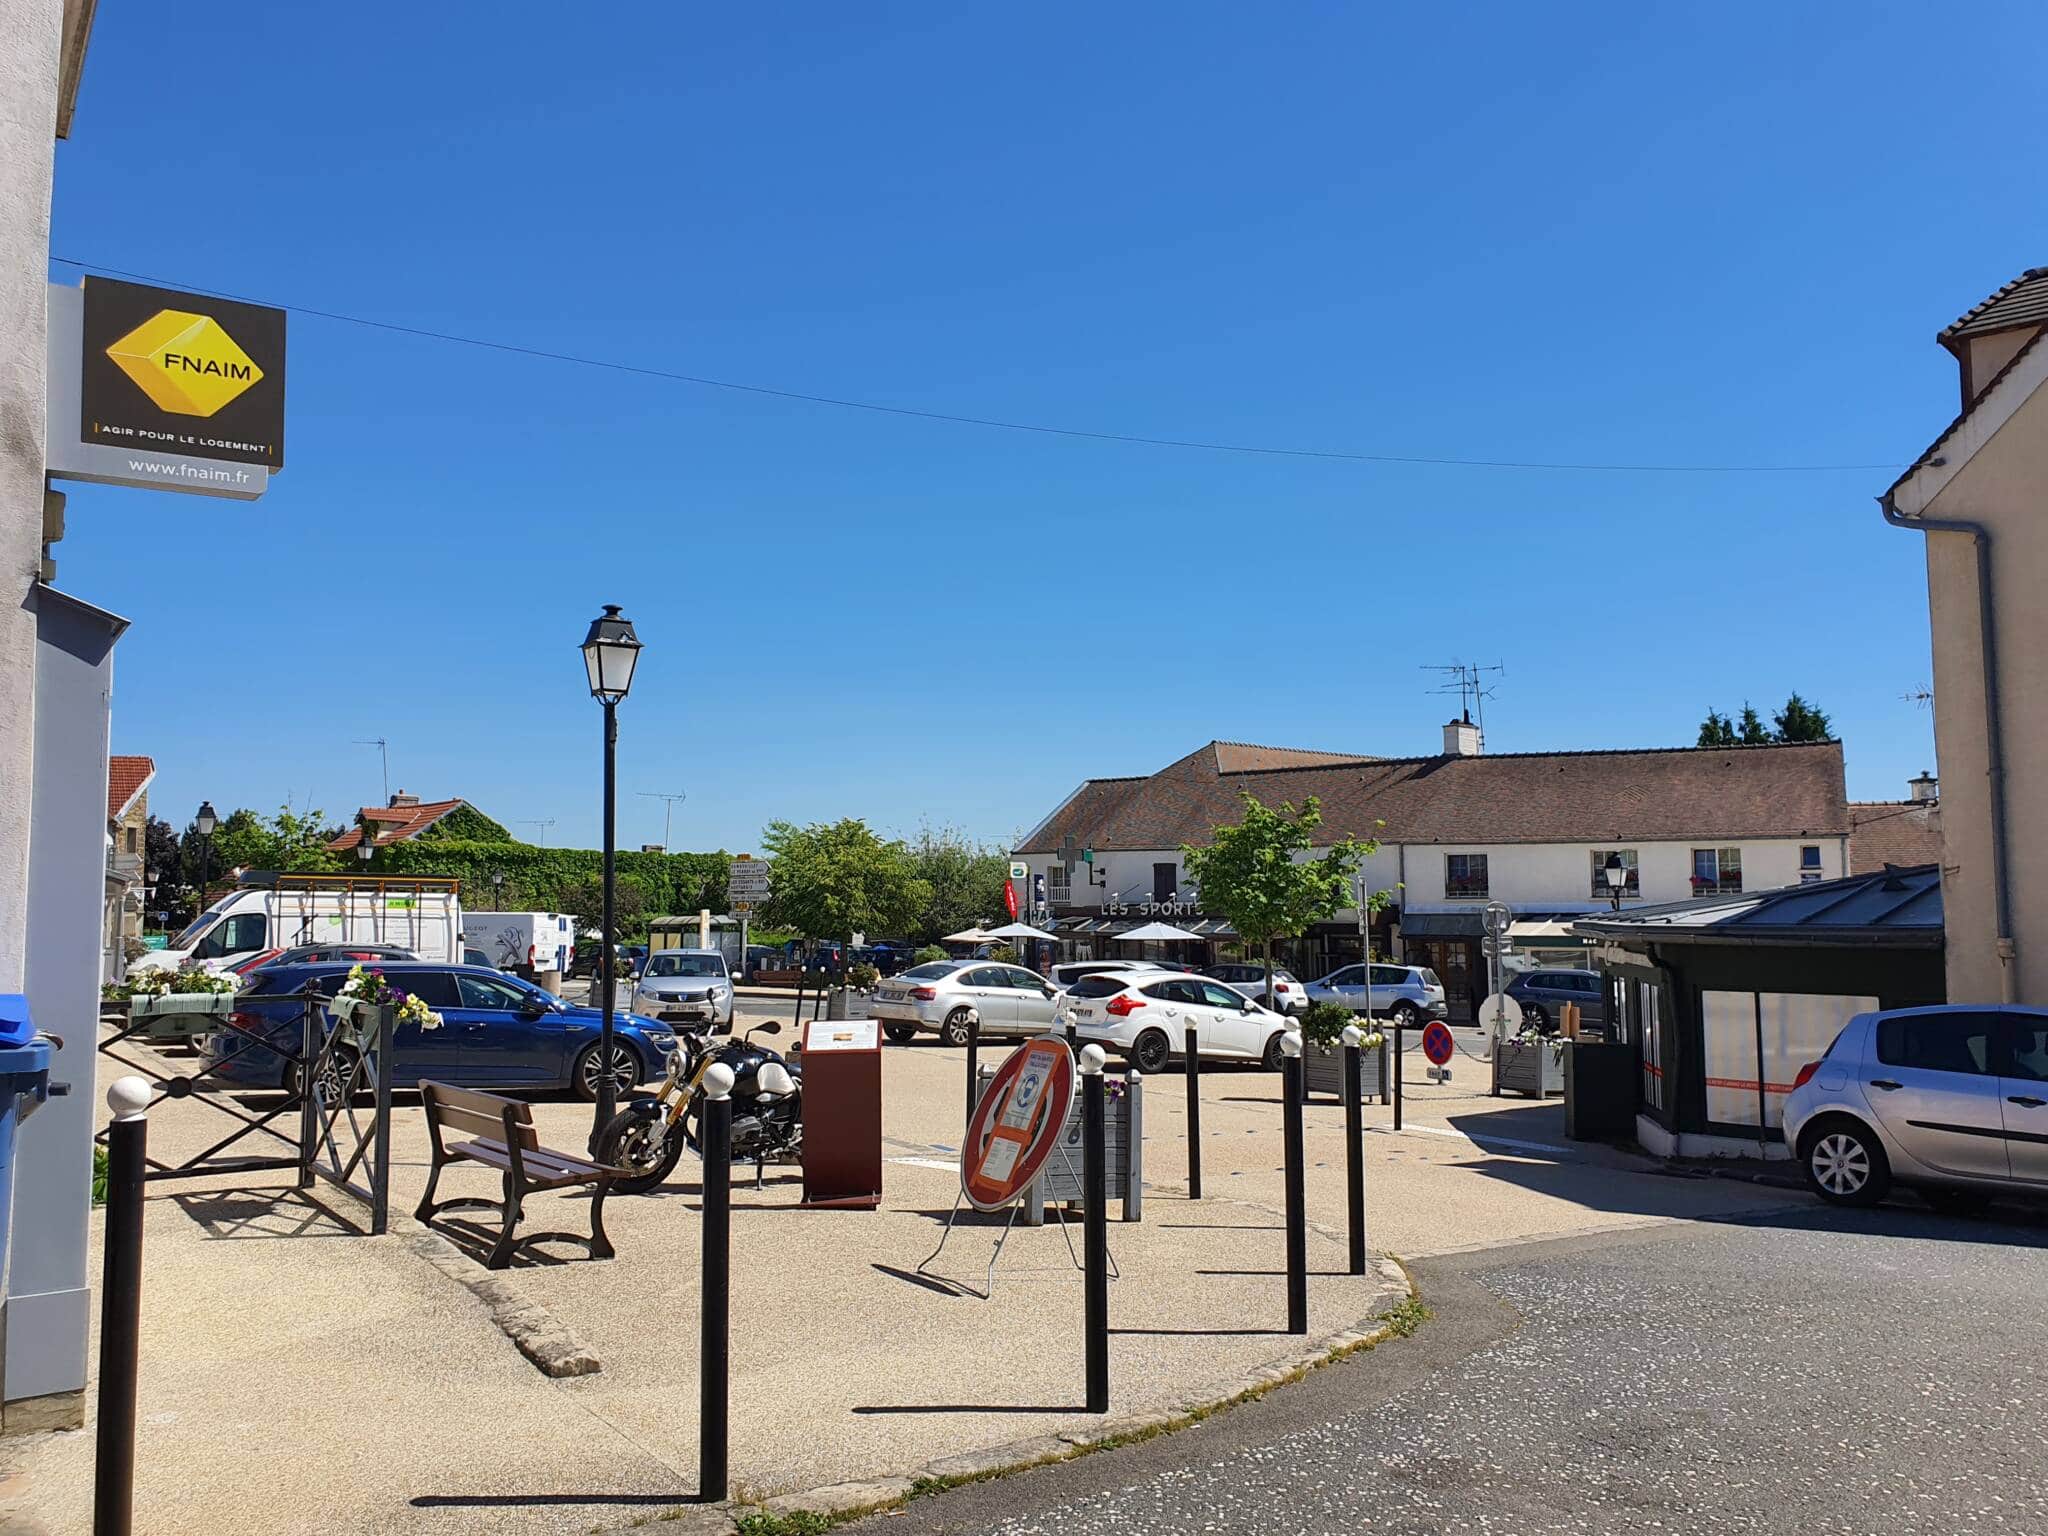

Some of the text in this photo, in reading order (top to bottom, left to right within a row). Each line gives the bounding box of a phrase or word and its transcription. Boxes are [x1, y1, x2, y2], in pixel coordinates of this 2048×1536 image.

[164, 353, 251, 381] FNAIM
[102, 425, 266, 453] AGIR POUR LE LOGEMENT
[128, 460, 250, 484] www.fnaim.fr
[1101, 902, 1129, 916] LES
